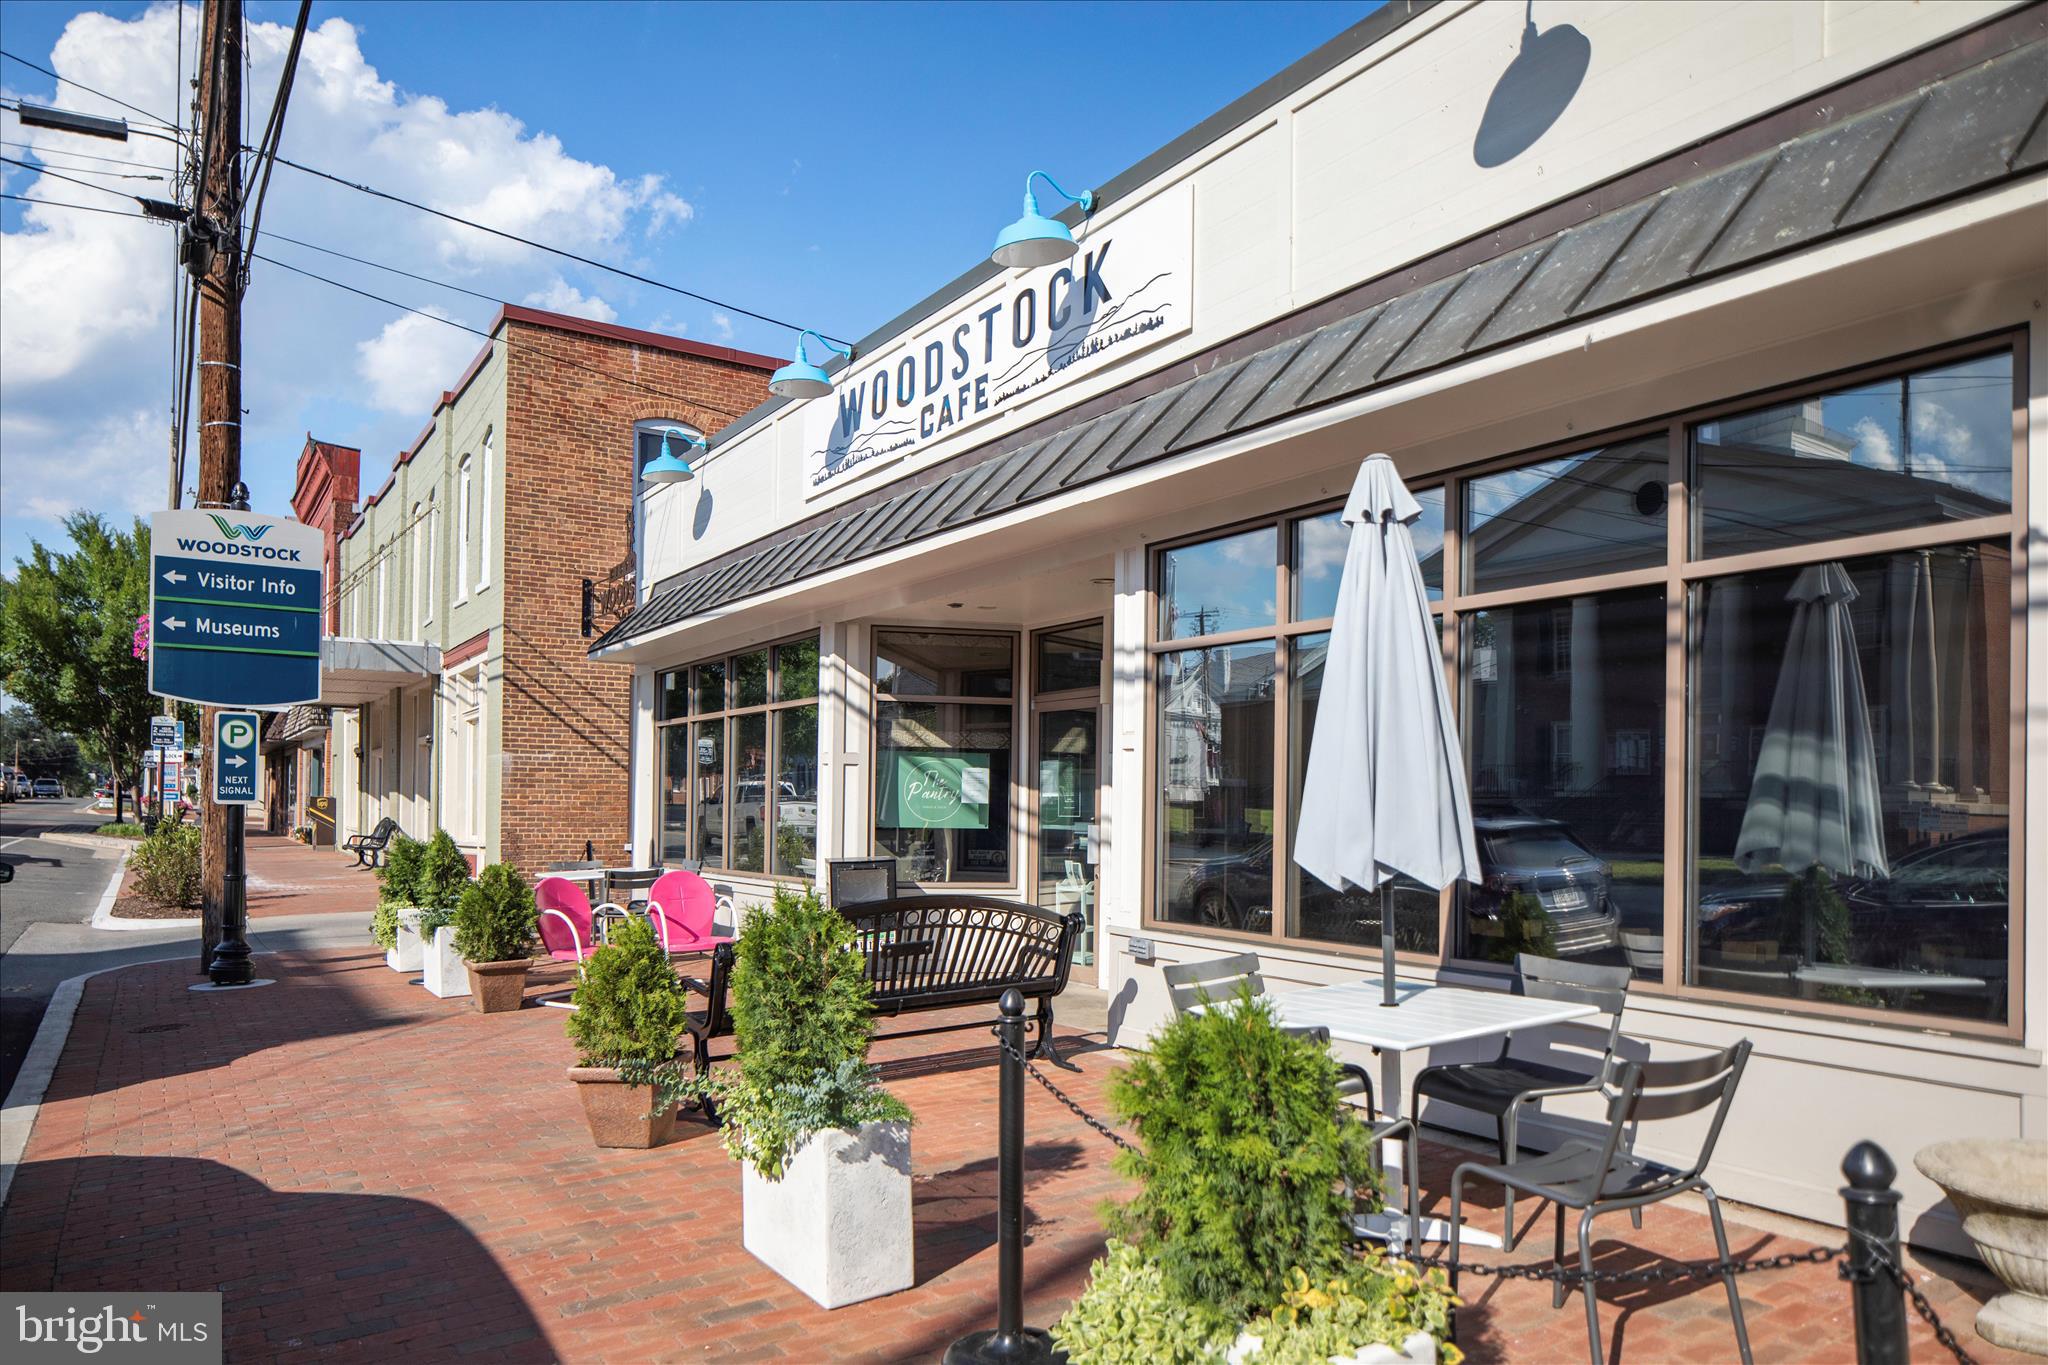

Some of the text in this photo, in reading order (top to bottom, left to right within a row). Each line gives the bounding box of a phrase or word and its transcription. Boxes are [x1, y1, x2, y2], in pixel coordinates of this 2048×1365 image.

[840, 239, 1113, 438] WOODSTOCK
[920, 373, 990, 440] CAFE
[177, 537, 302, 562] WOODSTOCK
[197, 571, 296, 596] Visitor Info
[196, 617, 280, 638] Museums
[229, 724, 248, 744] P
[219, 786, 254, 795] SIGNAL
[225, 776, 248, 784] NEXT
[907, 781, 960, 806] Pantry
